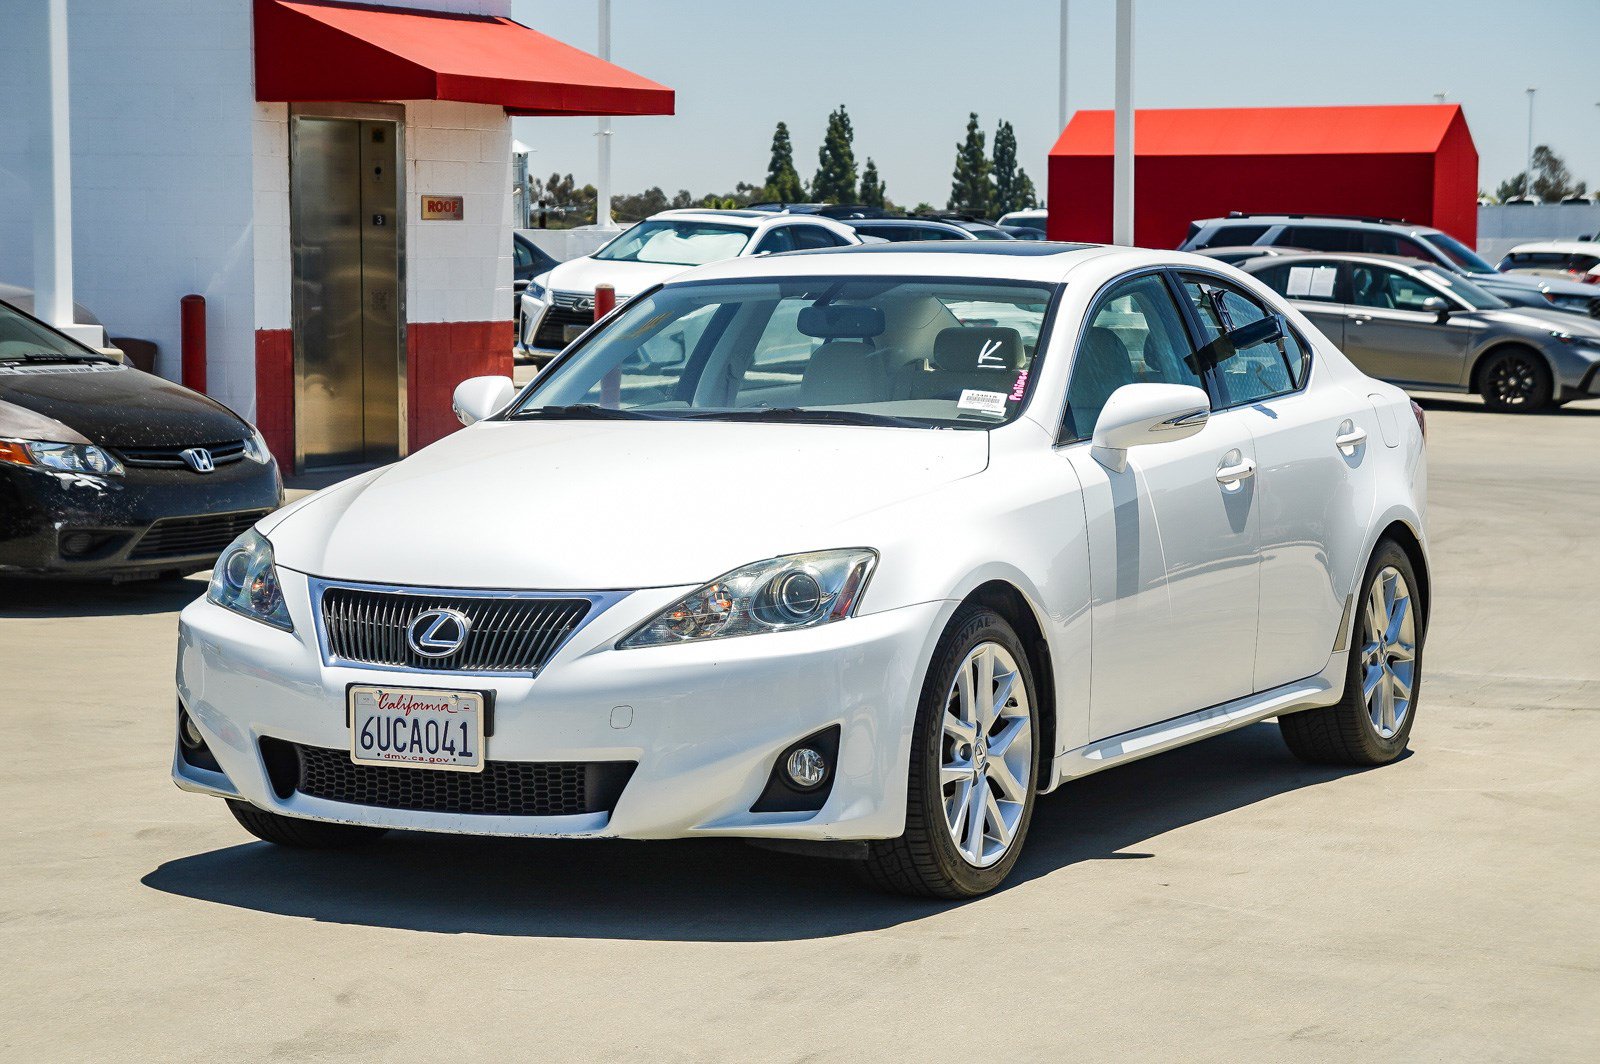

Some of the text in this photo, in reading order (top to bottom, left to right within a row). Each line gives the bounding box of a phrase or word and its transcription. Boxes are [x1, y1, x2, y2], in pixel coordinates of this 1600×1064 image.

[427, 200, 459, 213] ROOF
[376, 215, 384, 225] 3
[378, 692, 458, 716] California
[360, 716, 473, 758] 6UCA041
[384, 753, 450, 763] dmv.ca.gov
